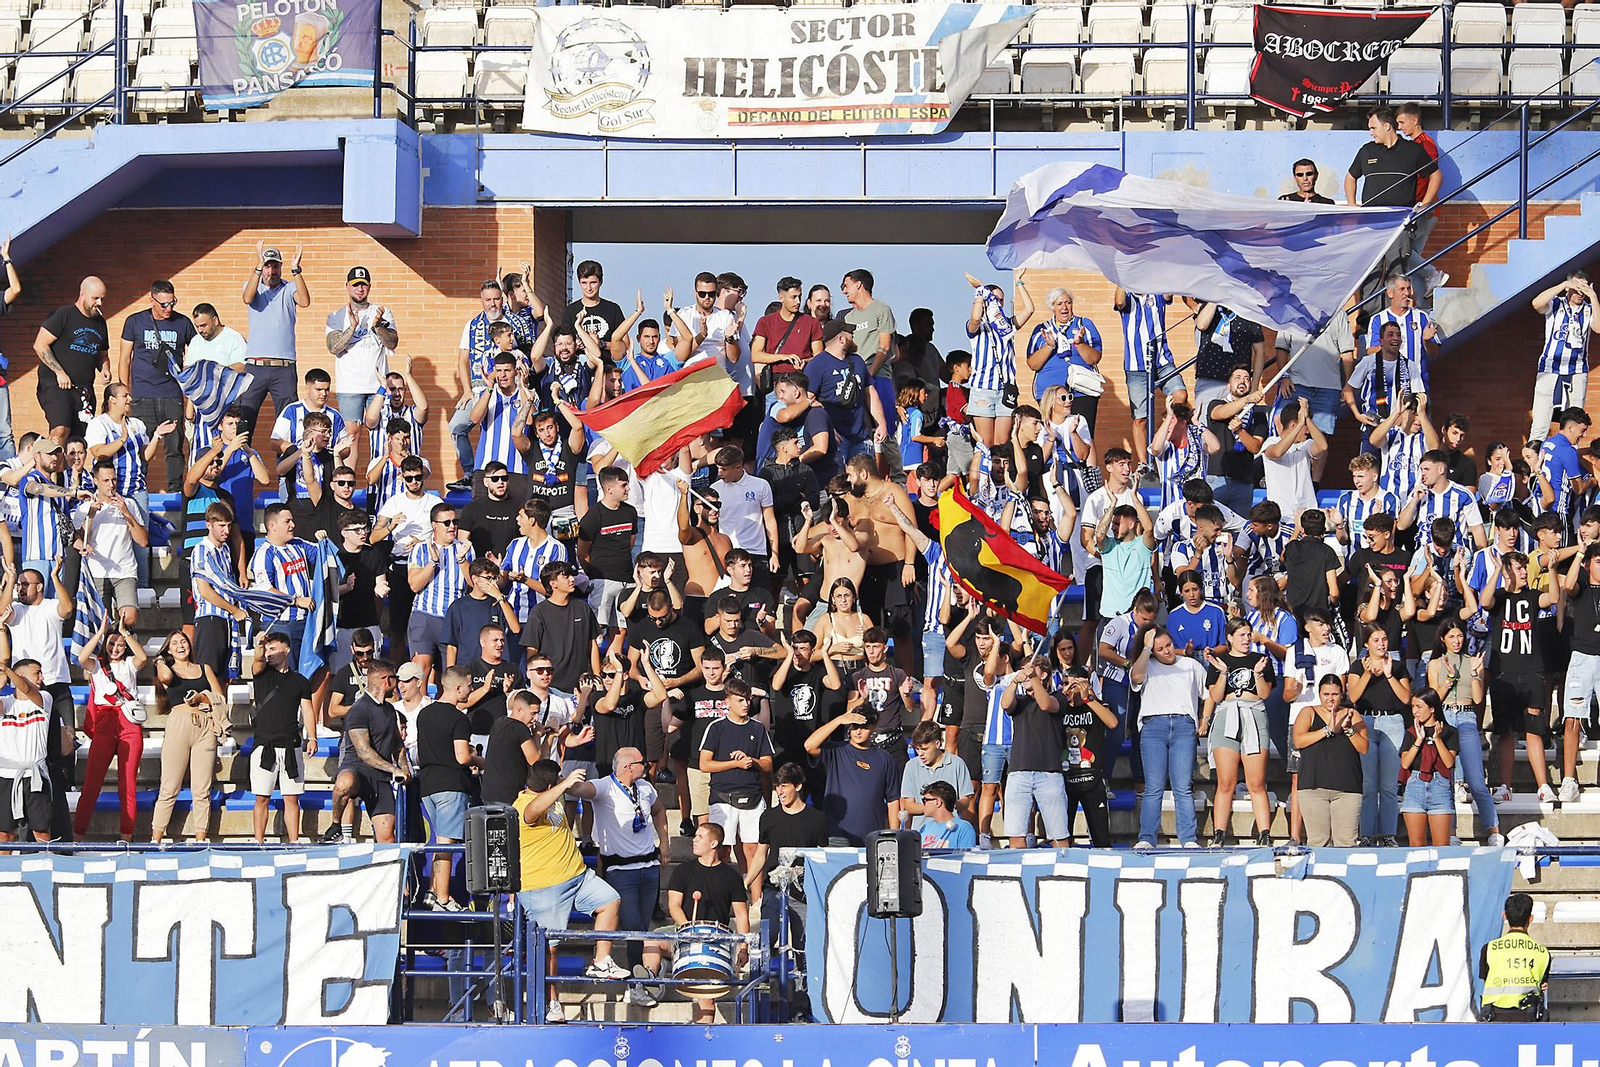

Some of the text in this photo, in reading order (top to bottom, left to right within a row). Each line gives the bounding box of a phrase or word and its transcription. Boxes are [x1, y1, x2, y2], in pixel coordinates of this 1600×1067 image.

[790, 12, 915, 44] SECTOR
[553, 101, 580, 114] Sector
[600, 108, 645, 127] Gol Sur
[738, 110, 801, 124] DECANO
[808, 109, 837, 122] DEL
[854, 321, 869, 331] OSS
[144, 329, 178, 343] DEANO
[866, 677, 892, 690] UST
[1491, 938, 1545, 953] SEGURIDAD
[1507, 958, 1535, 970] 1514
[1503, 976, 1539, 985] PROSEG
